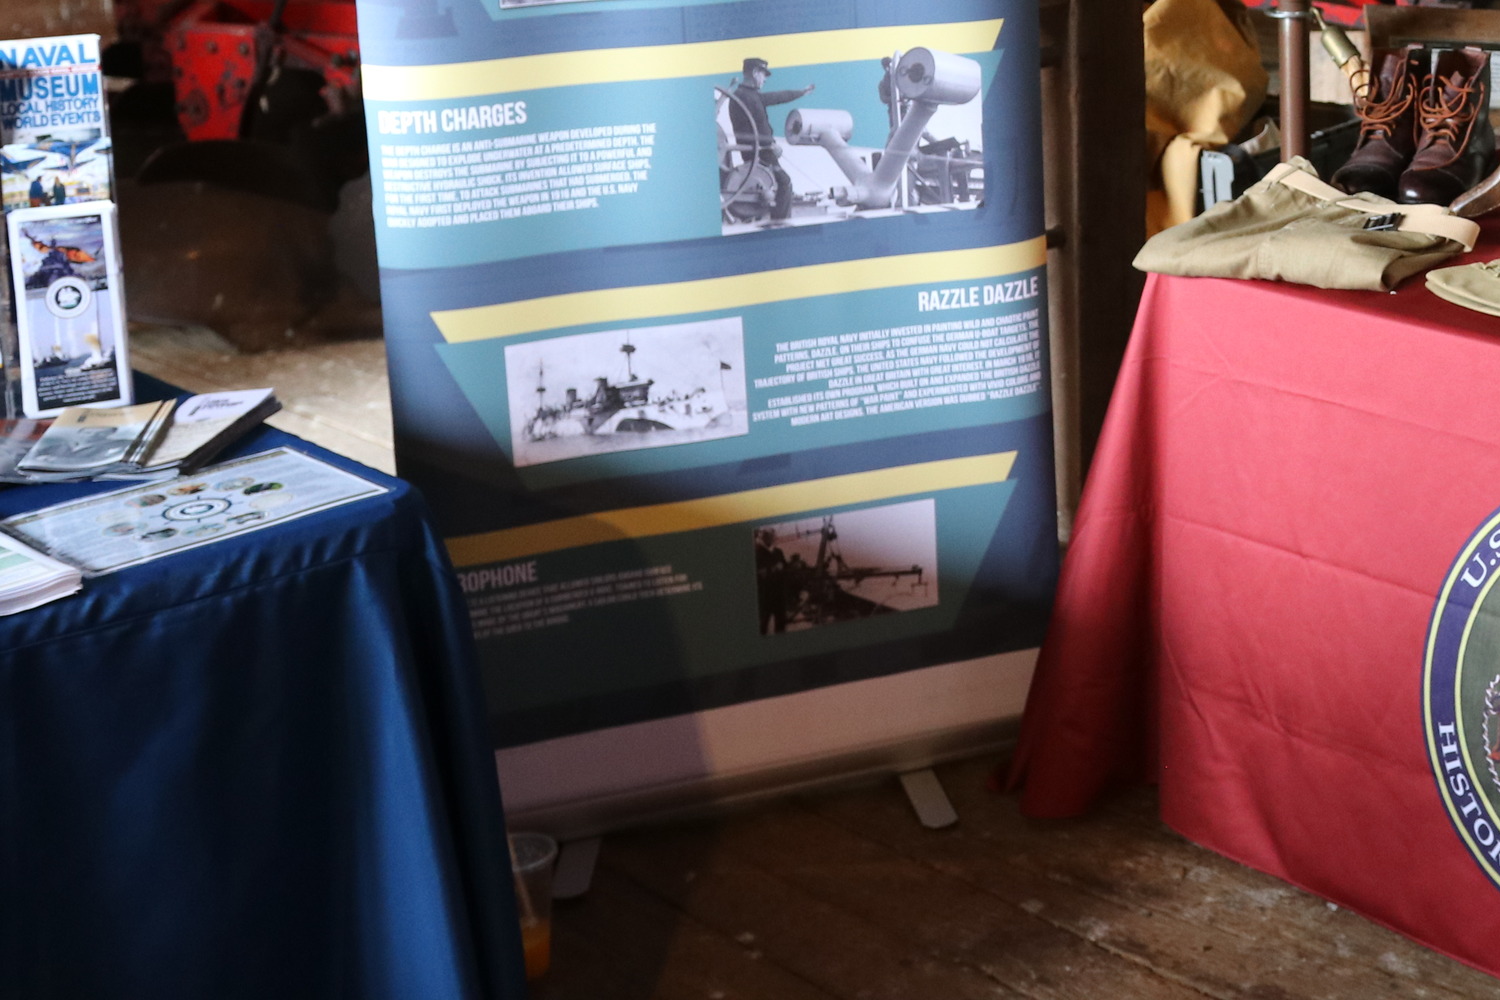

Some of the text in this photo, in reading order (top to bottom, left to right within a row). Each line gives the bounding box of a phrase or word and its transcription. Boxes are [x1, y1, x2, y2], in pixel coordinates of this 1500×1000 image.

[0, 44, 96, 69] NAVAL
[0, 74, 98, 102] MUSEUM
[1, 97, 98, 116] LOCAL HISTORY
[377, 101, 528, 135] DEPTH CHARGES
[2, 110, 101, 130] WORLD EVENTS
[918, 276, 1038, 312] RAZZLE DAZZLE
